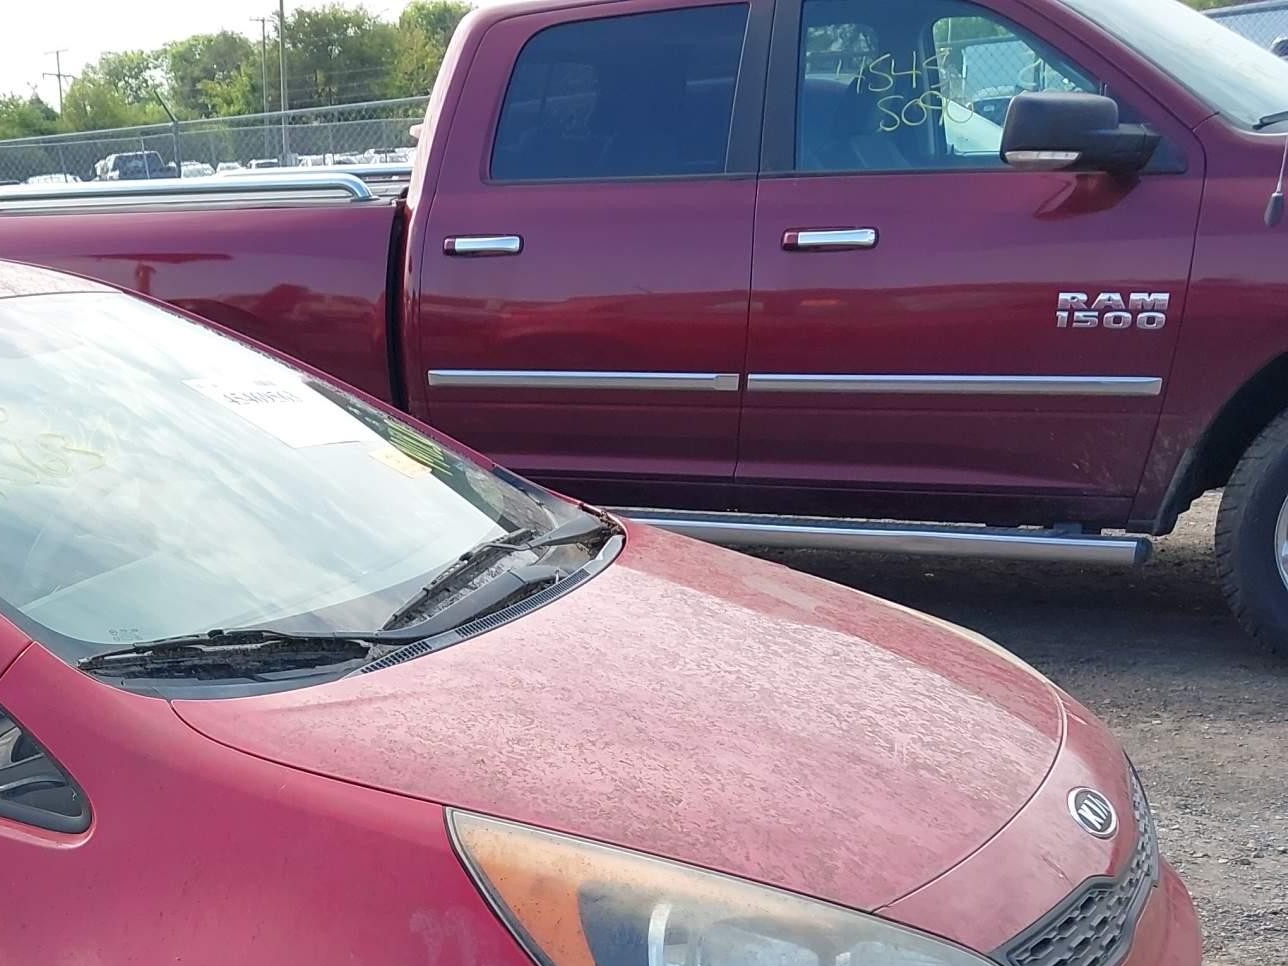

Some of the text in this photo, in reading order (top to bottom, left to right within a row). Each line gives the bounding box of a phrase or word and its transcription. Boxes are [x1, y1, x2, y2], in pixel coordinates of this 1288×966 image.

[876, 90, 975, 132] 5090
[1057, 292, 1170, 310] RAM
[1055, 311, 1166, 329] 1500
[1077, 793, 1111, 830] KIA
